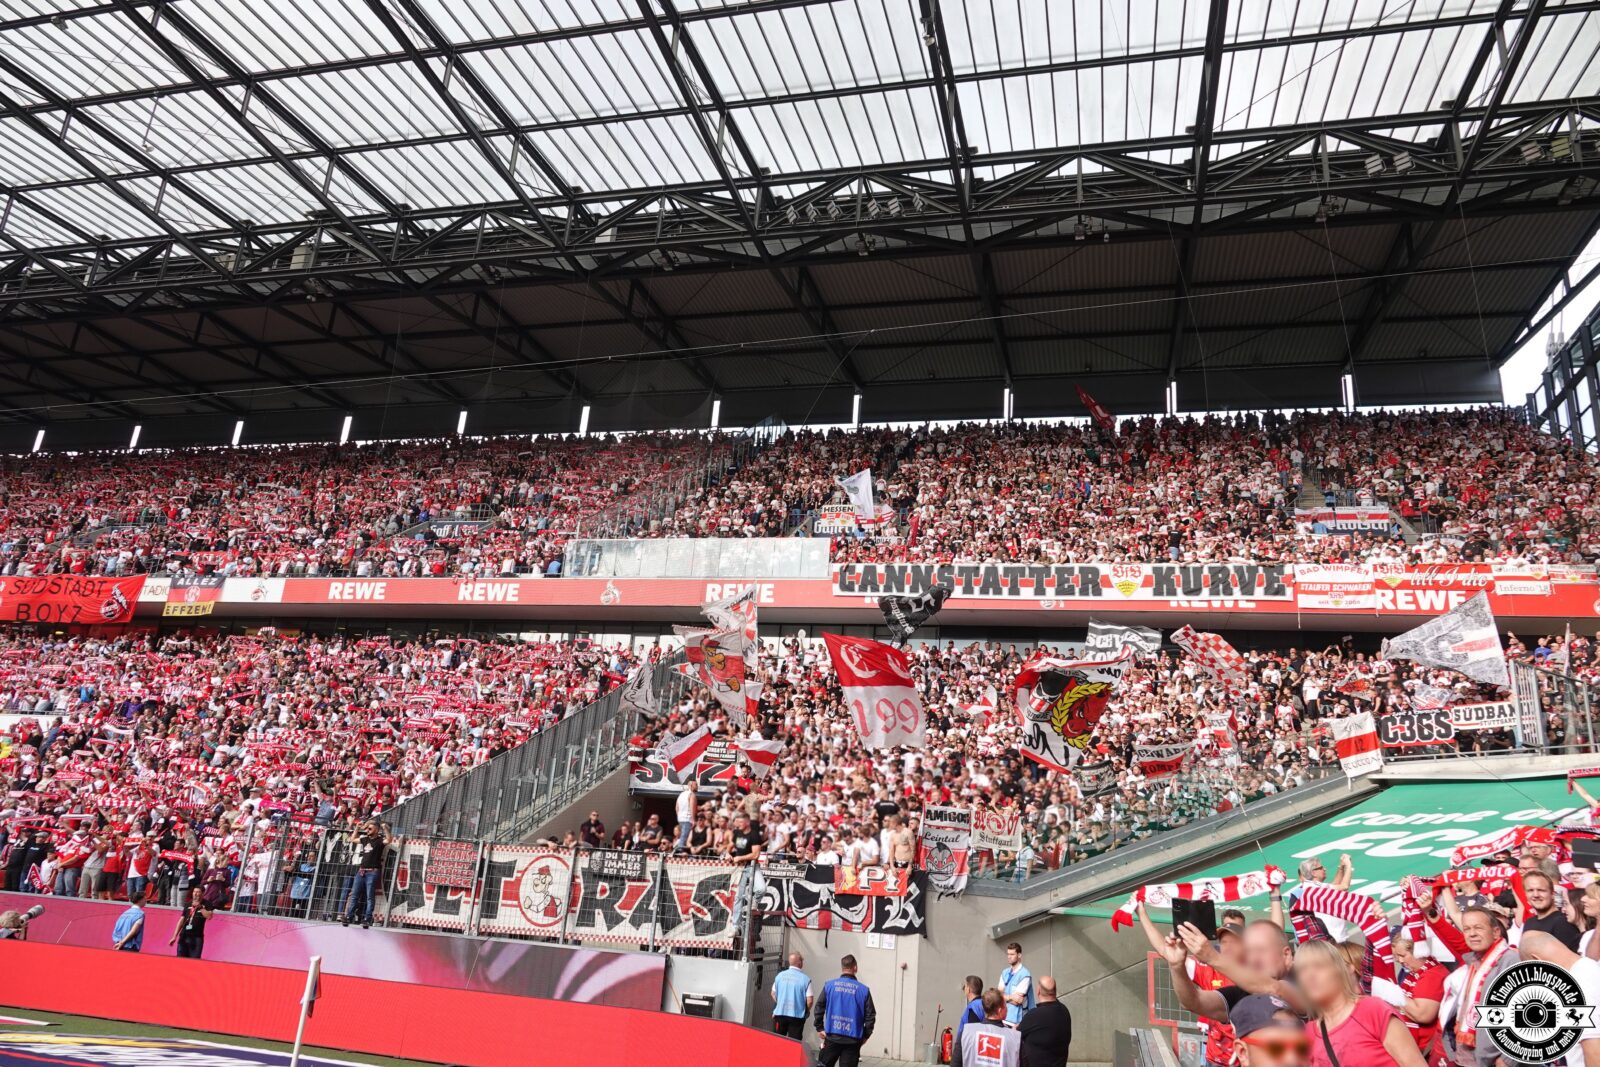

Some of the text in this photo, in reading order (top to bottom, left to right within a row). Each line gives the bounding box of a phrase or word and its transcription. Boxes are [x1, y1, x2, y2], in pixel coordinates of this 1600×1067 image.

[1299, 566, 1320, 576] BAD
[176, 577, 218, 586] ALLEZ
[838, 565, 1287, 597] CANNSTATTER KURVE
[328, 582, 387, 600] REWE
[458, 582, 520, 602] REWE
[1377, 590, 1467, 611] REWE
[1330, 811, 1500, 828] Come
[923, 830, 961, 843] Leintal
[979, 831, 1013, 848] Stuttgart
[605, 851, 643, 862] DU BIST
[603, 867, 618, 875] BEI
[604, 860, 641, 870] IMMER
[1458, 868, 1475, 881] FC
[834, 981, 859, 990] SECURITY
[834, 986, 856, 995] SERVICE
